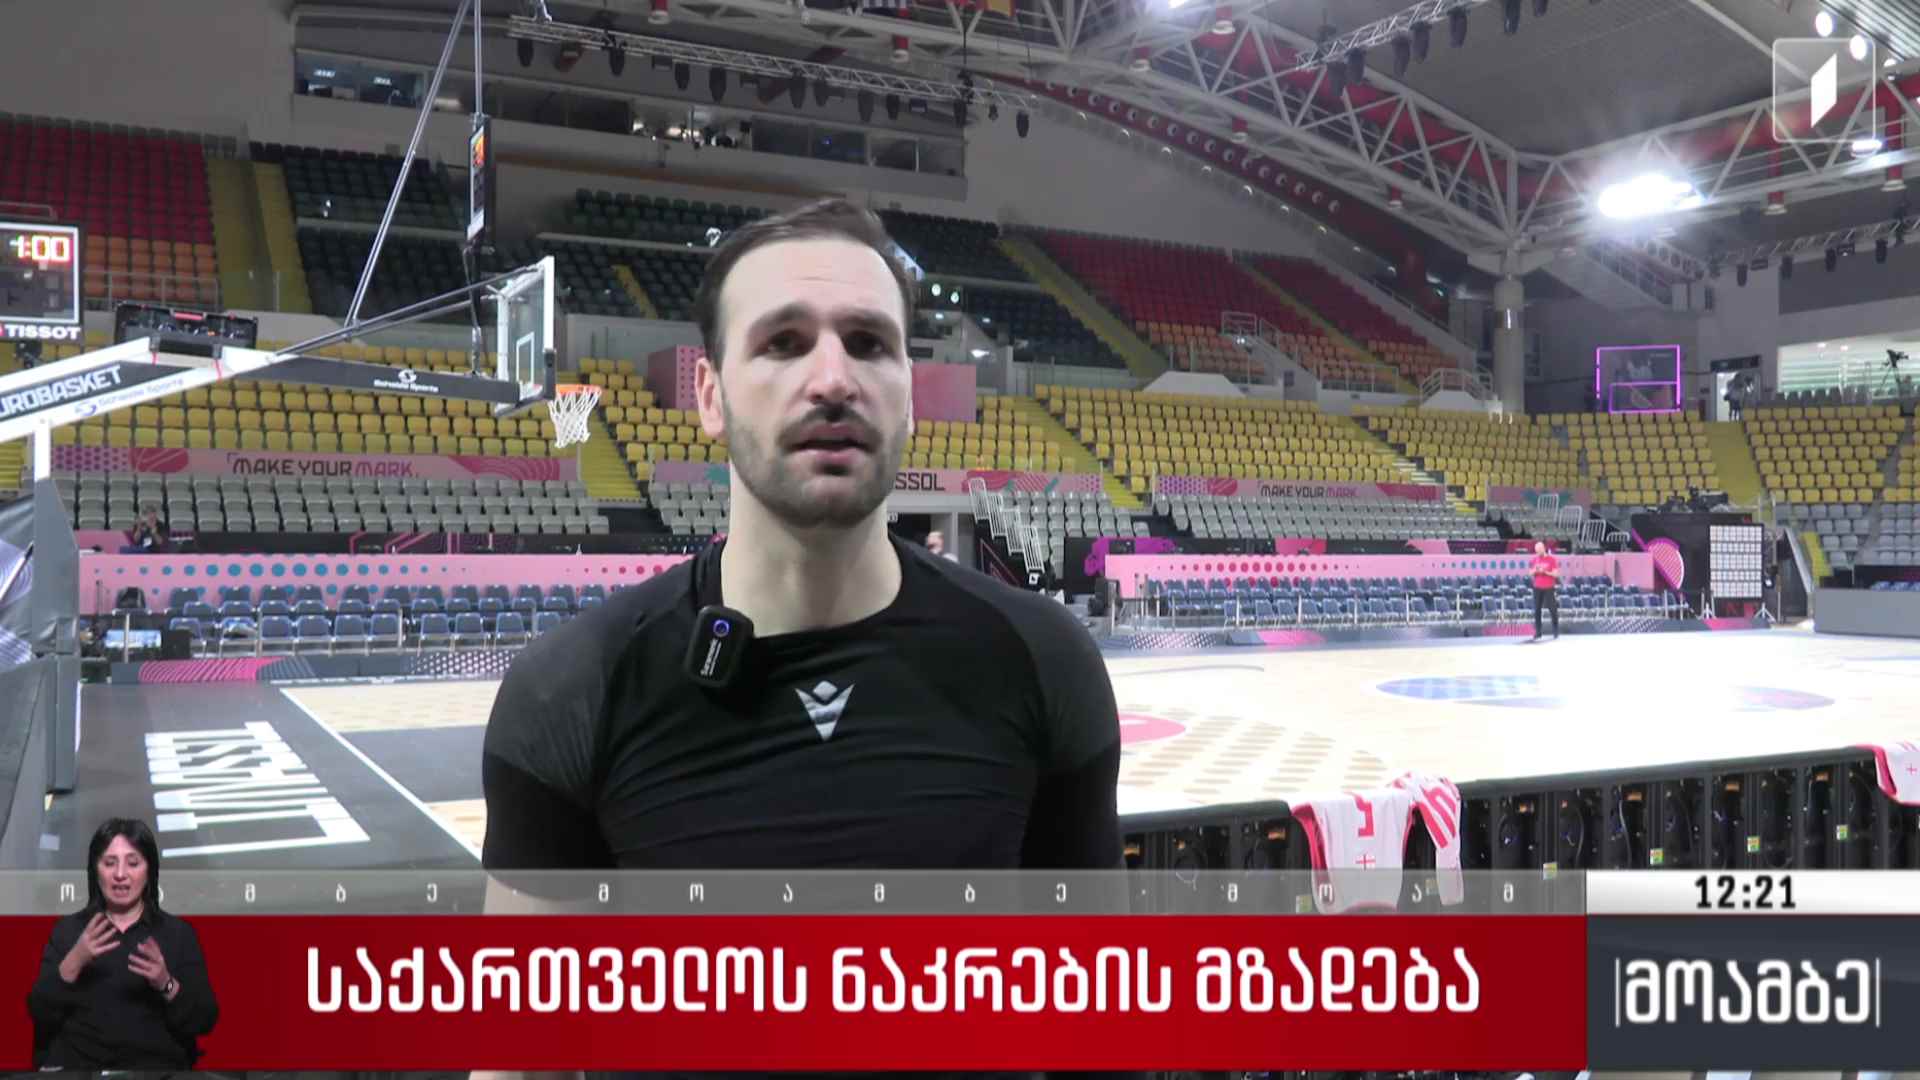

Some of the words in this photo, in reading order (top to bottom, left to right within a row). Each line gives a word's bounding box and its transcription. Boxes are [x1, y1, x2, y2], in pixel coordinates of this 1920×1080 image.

[4, 324, 81, 340] TISSOT
[232, 458, 294, 476] MAKE
[298, 459, 353, 477] YOUR
[895, 472, 946, 491] SSOL
[1261, 484, 1294, 497] MAKE
[1295, 485, 1326, 499] YOUR
